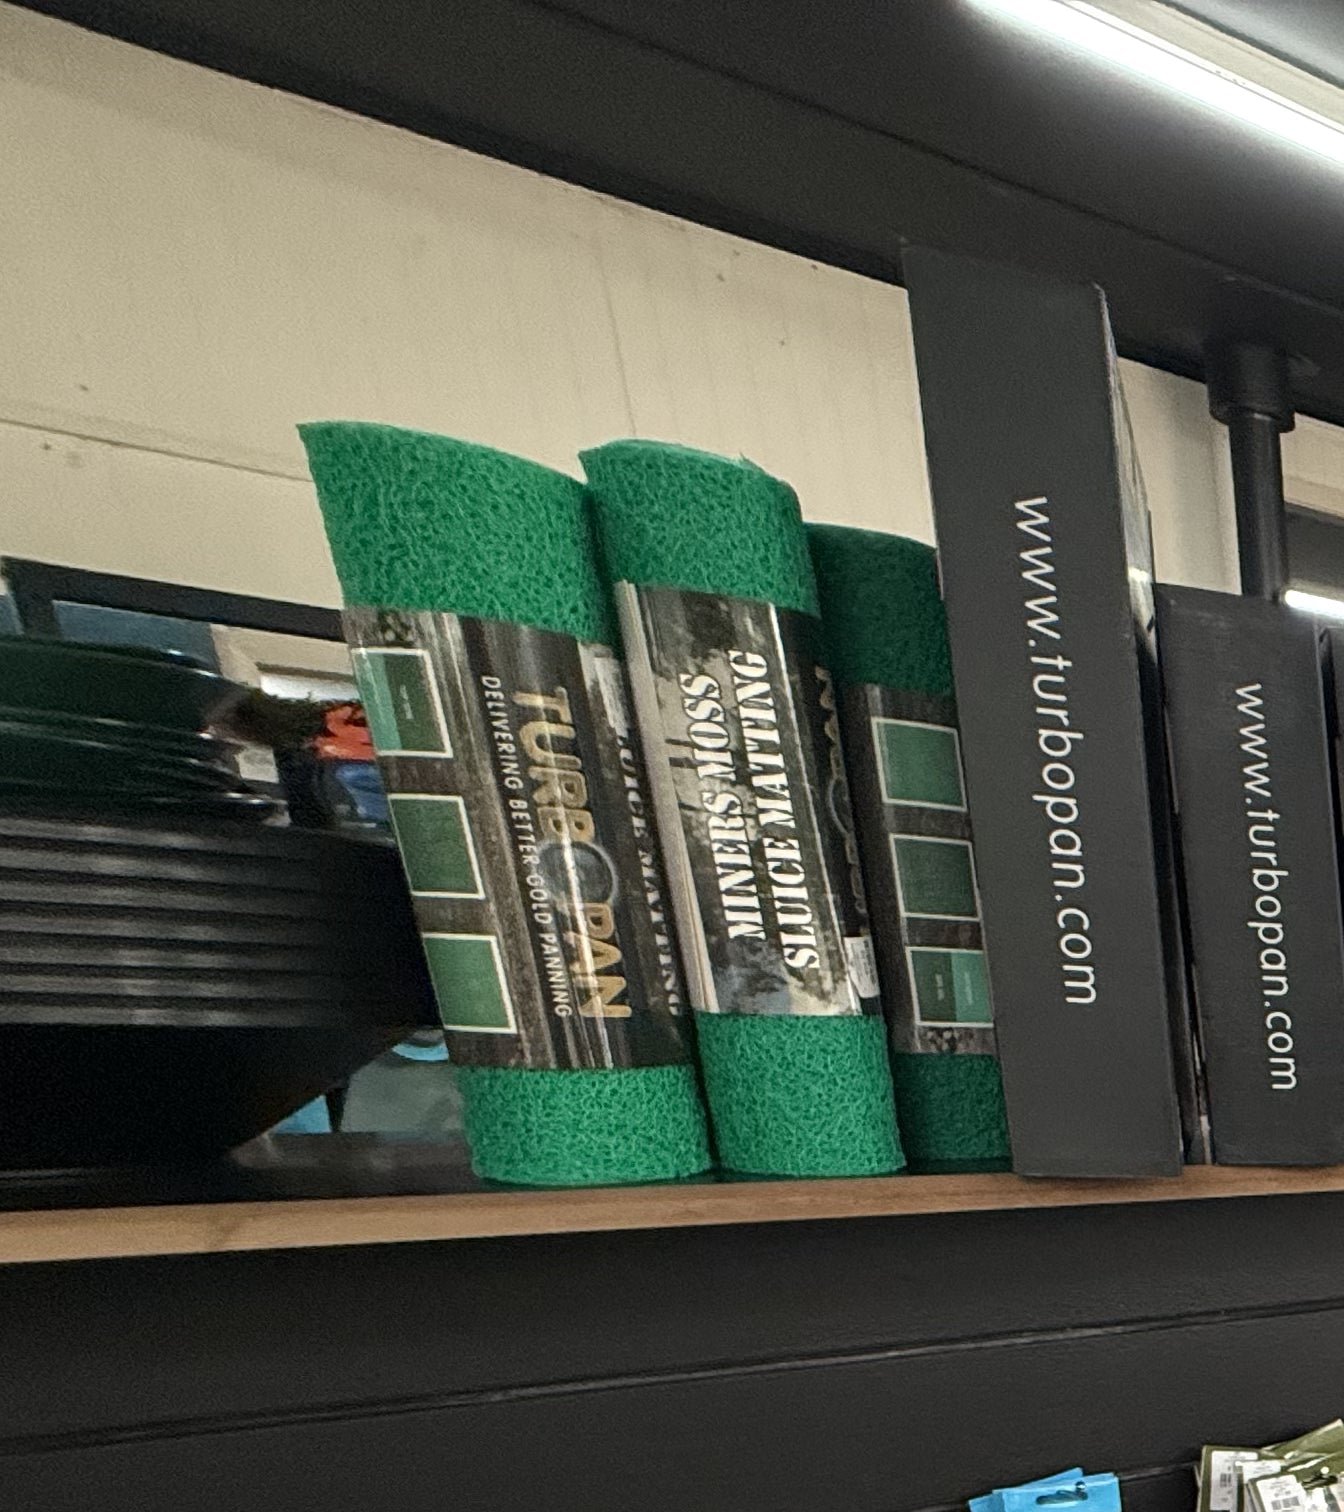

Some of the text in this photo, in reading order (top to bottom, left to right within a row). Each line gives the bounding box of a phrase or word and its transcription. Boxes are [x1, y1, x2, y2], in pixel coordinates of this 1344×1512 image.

[482, 675, 573, 1018] DELIVERING BETTER GOLD PANNING
[679, 672, 766, 940] MINERS MOSS
[728, 649, 820, 969] SLUICE MATTING
[1014, 496, 1097, 1004] www.turbopan.com
[1235, 683, 1298, 1091] www.turbopan.com
[638, 850, 680, 1017] MATTING
